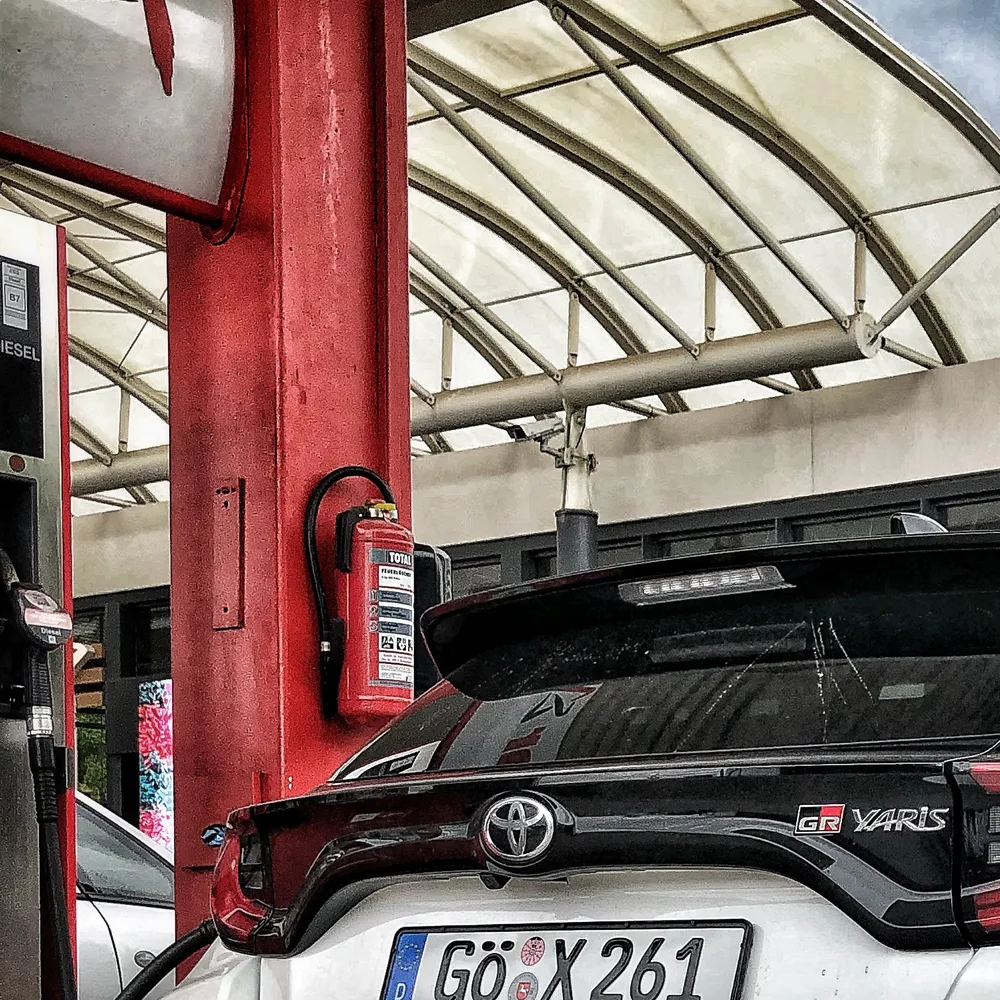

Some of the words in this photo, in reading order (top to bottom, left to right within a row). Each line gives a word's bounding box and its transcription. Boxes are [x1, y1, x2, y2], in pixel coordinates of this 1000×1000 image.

[9, 292, 21, 303] B7
[0, 339, 41, 362] IESEL
[389, 551, 412, 566] TOTAL
[798, 815, 842, 832] GR
